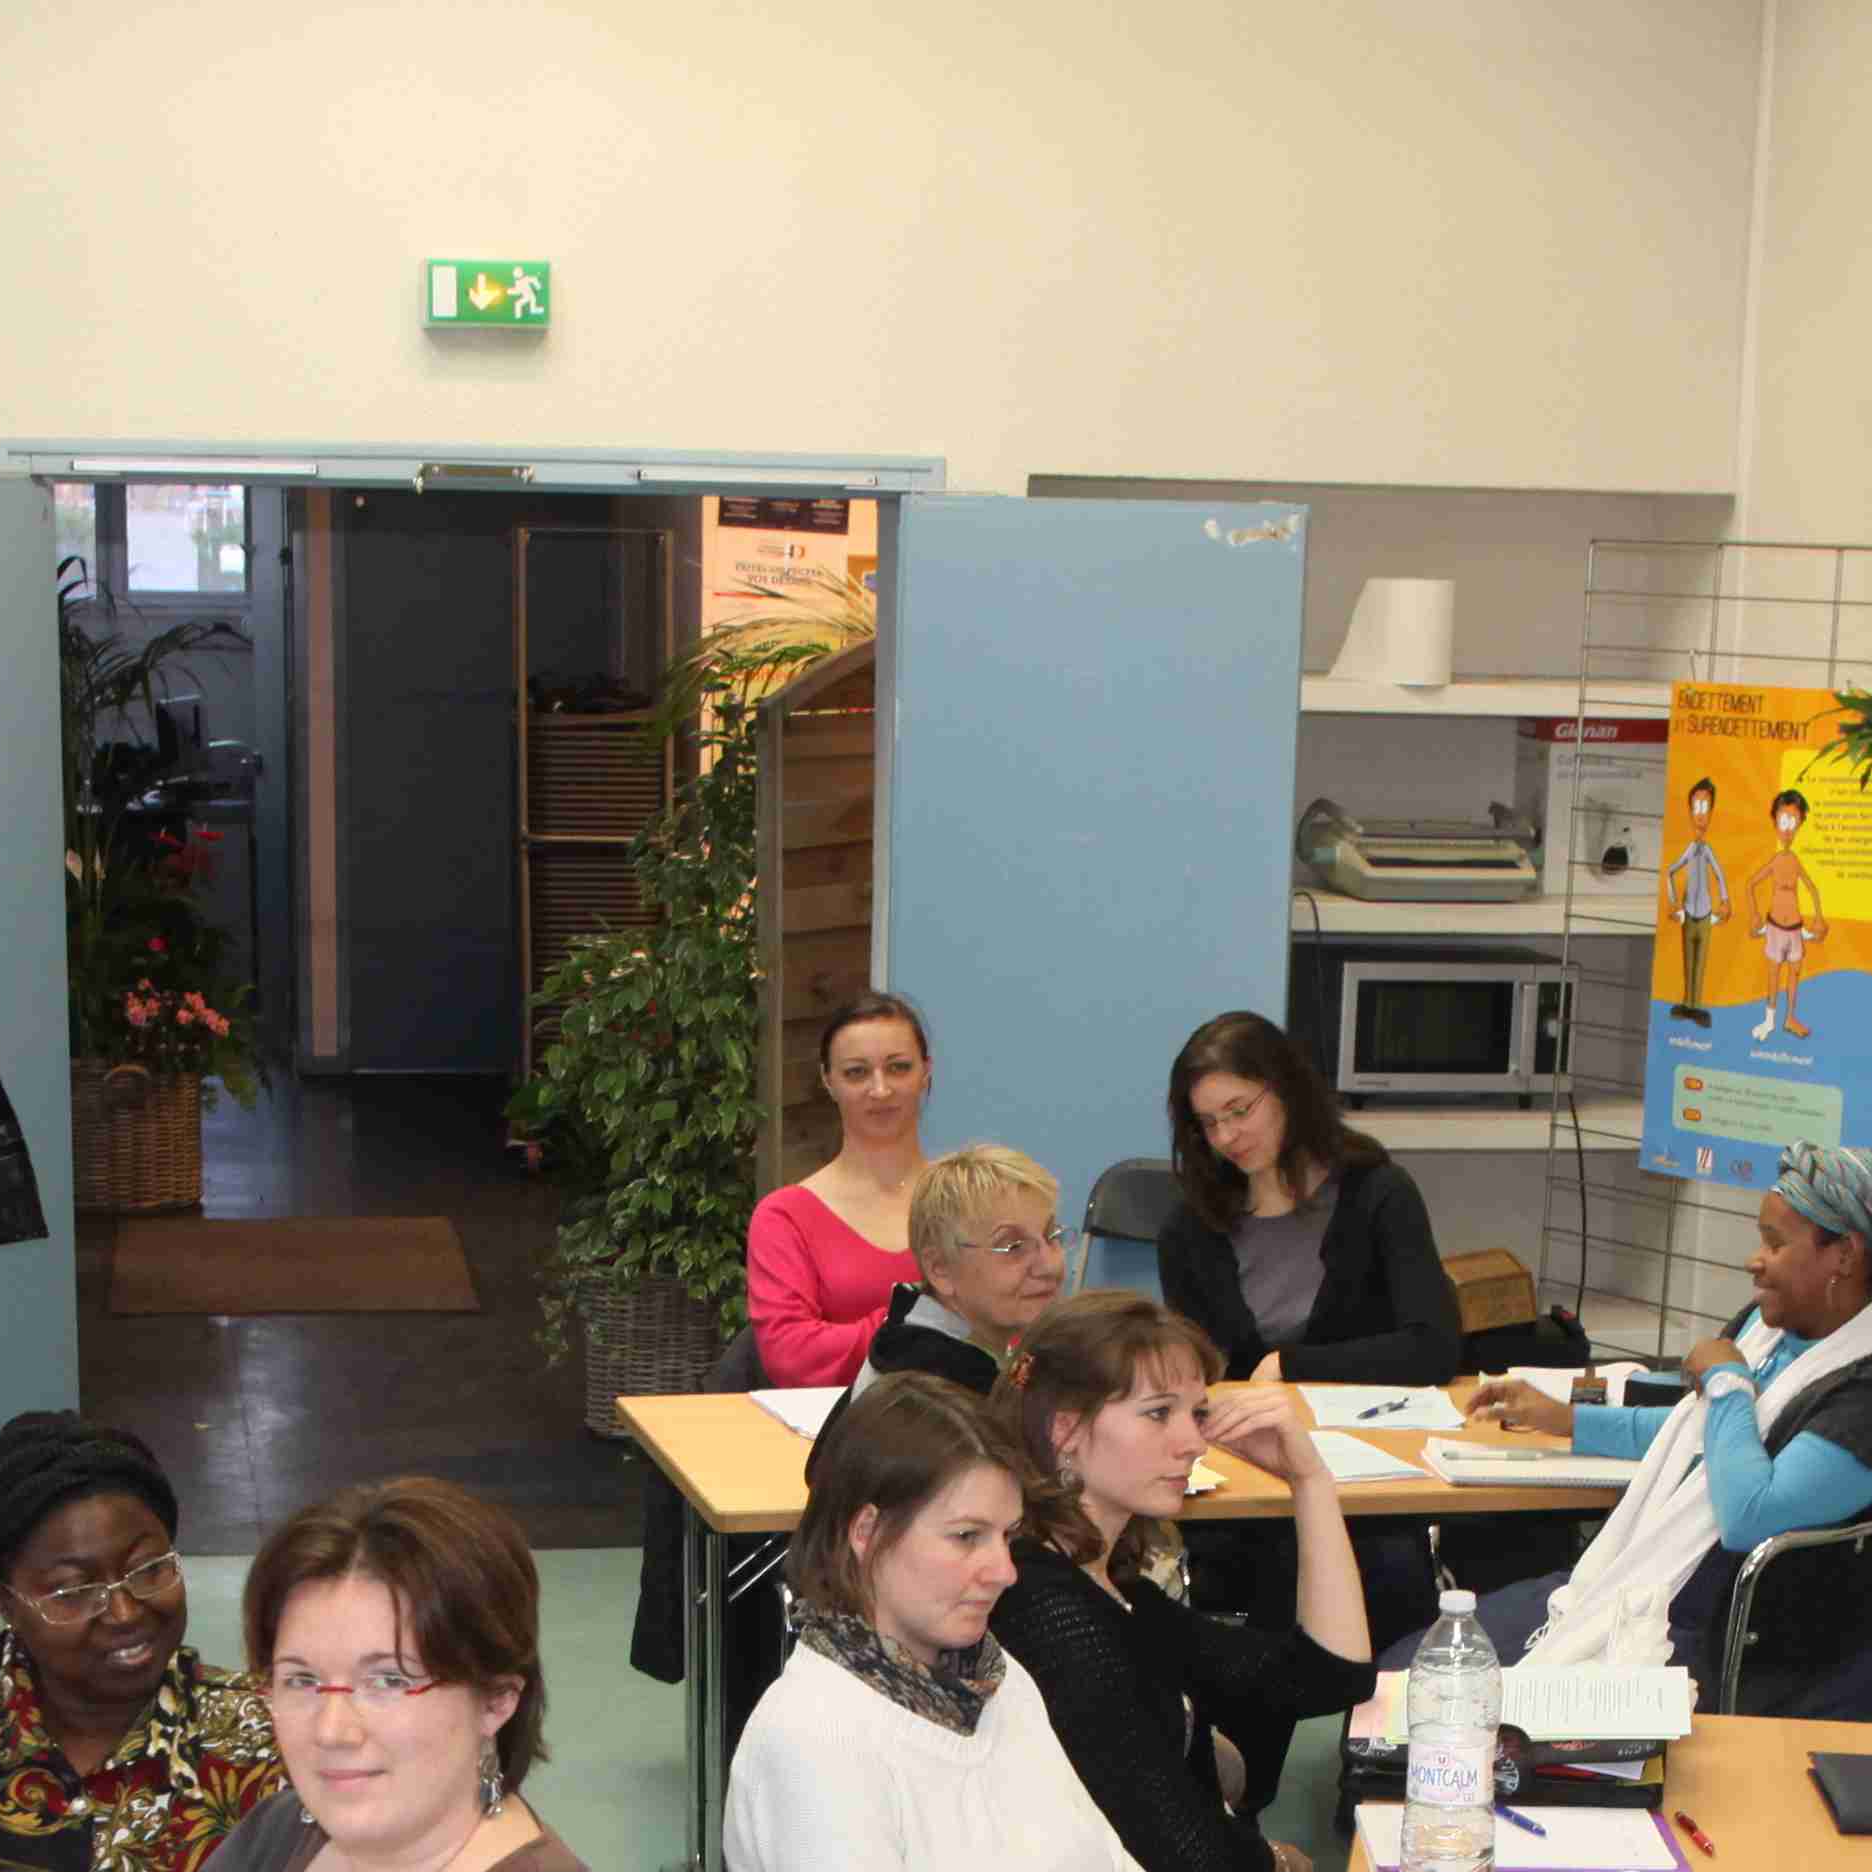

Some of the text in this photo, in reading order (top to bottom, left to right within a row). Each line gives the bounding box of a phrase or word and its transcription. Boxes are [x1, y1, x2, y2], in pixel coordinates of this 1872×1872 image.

[1679, 688, 1764, 715] ENDETTEMENT
[1555, 722, 1619, 739] Glnan
[1687, 714, 1811, 742] SURENDETTEMENT
[1407, 1764, 1478, 1787] MONTCALM
